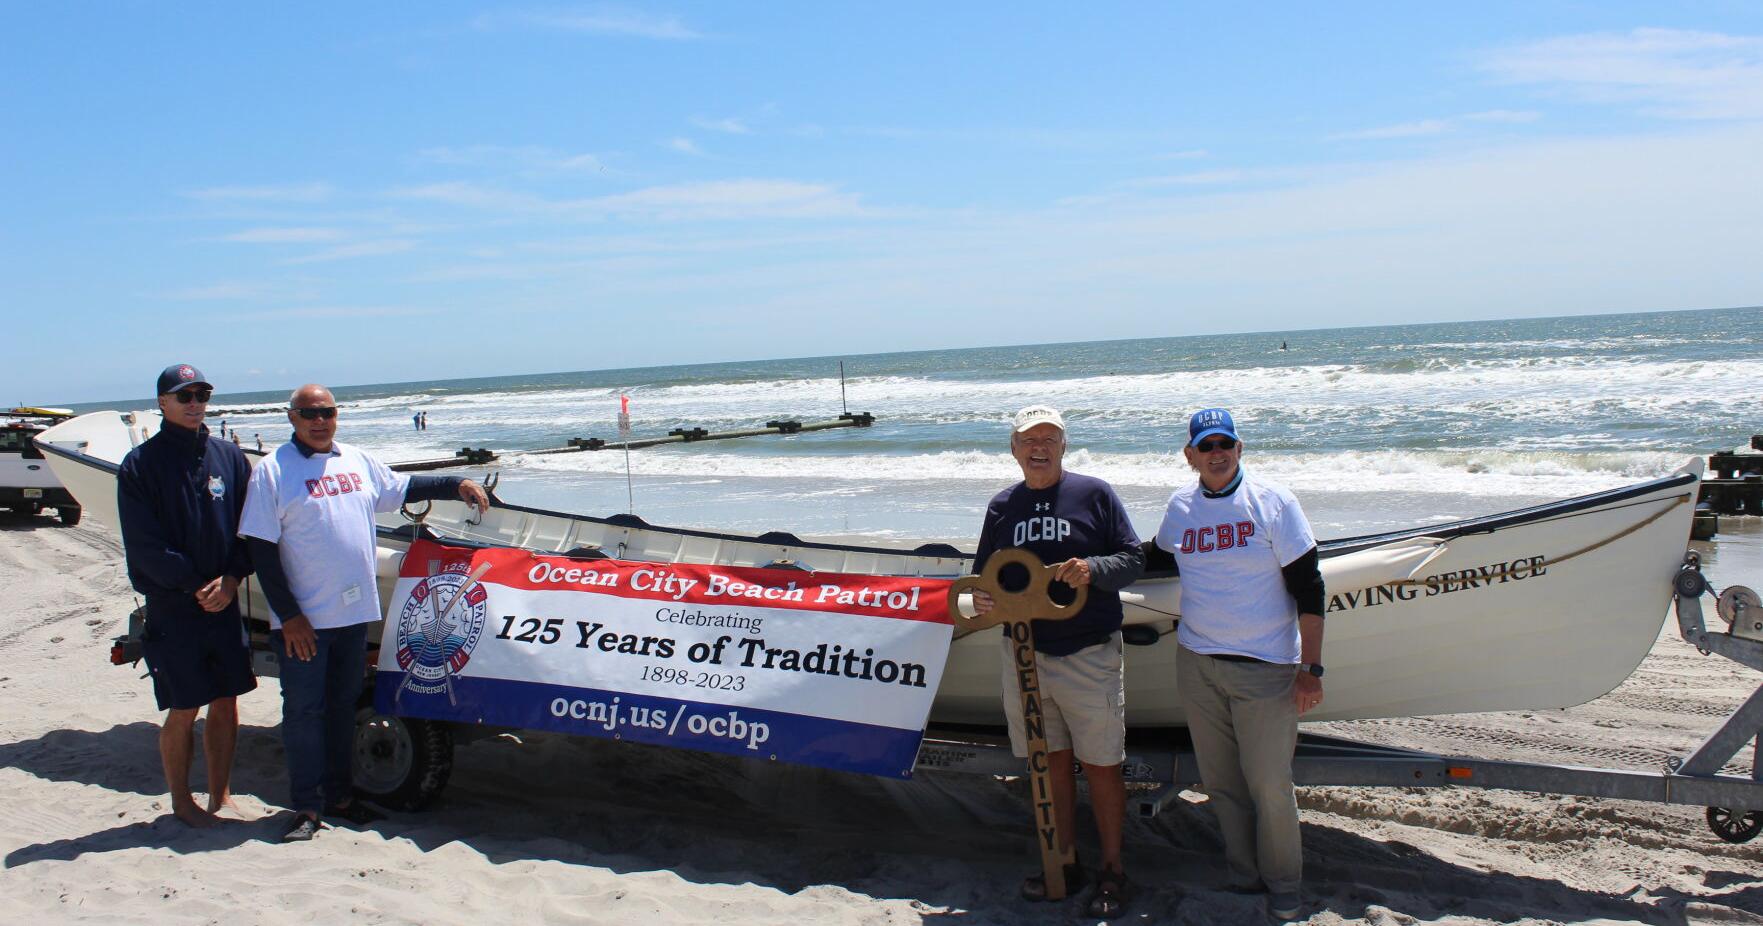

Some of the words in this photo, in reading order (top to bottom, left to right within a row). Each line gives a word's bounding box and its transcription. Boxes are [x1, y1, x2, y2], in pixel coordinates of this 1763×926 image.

[1198, 411, 1223, 423] OCBP
[305, 472, 363, 499] OCBP
[1014, 517, 1070, 546] OCBP
[1181, 520, 1255, 554] OCBP
[442, 562, 473, 574] 125th
[528, 562, 618, 590] Ocean
[629, 568, 697, 601] City
[704, 575, 804, 602] Beach
[814, 583, 922, 612] Patrol
[1327, 579, 1418, 613] AVING
[1425, 555, 1547, 597] SERVICE
[399, 602, 415, 647] BEACH
[464, 604, 485, 651] PATROL
[655, 606, 763, 634] Celebrating
[496, 614, 564, 644] 125
[575, 621, 675, 658] Years
[687, 634, 732, 664] of
[739, 638, 928, 688] Tradition
[415, 664, 432, 673] OCEAN
[640, 665, 746, 692] 1898-2023
[406, 679, 447, 695] Anniversary
[550, 694, 770, 748] ocnj.us/ocbp
[1014, 621, 1044, 741] OCEAN
[1031, 750, 1056, 851] CITY
